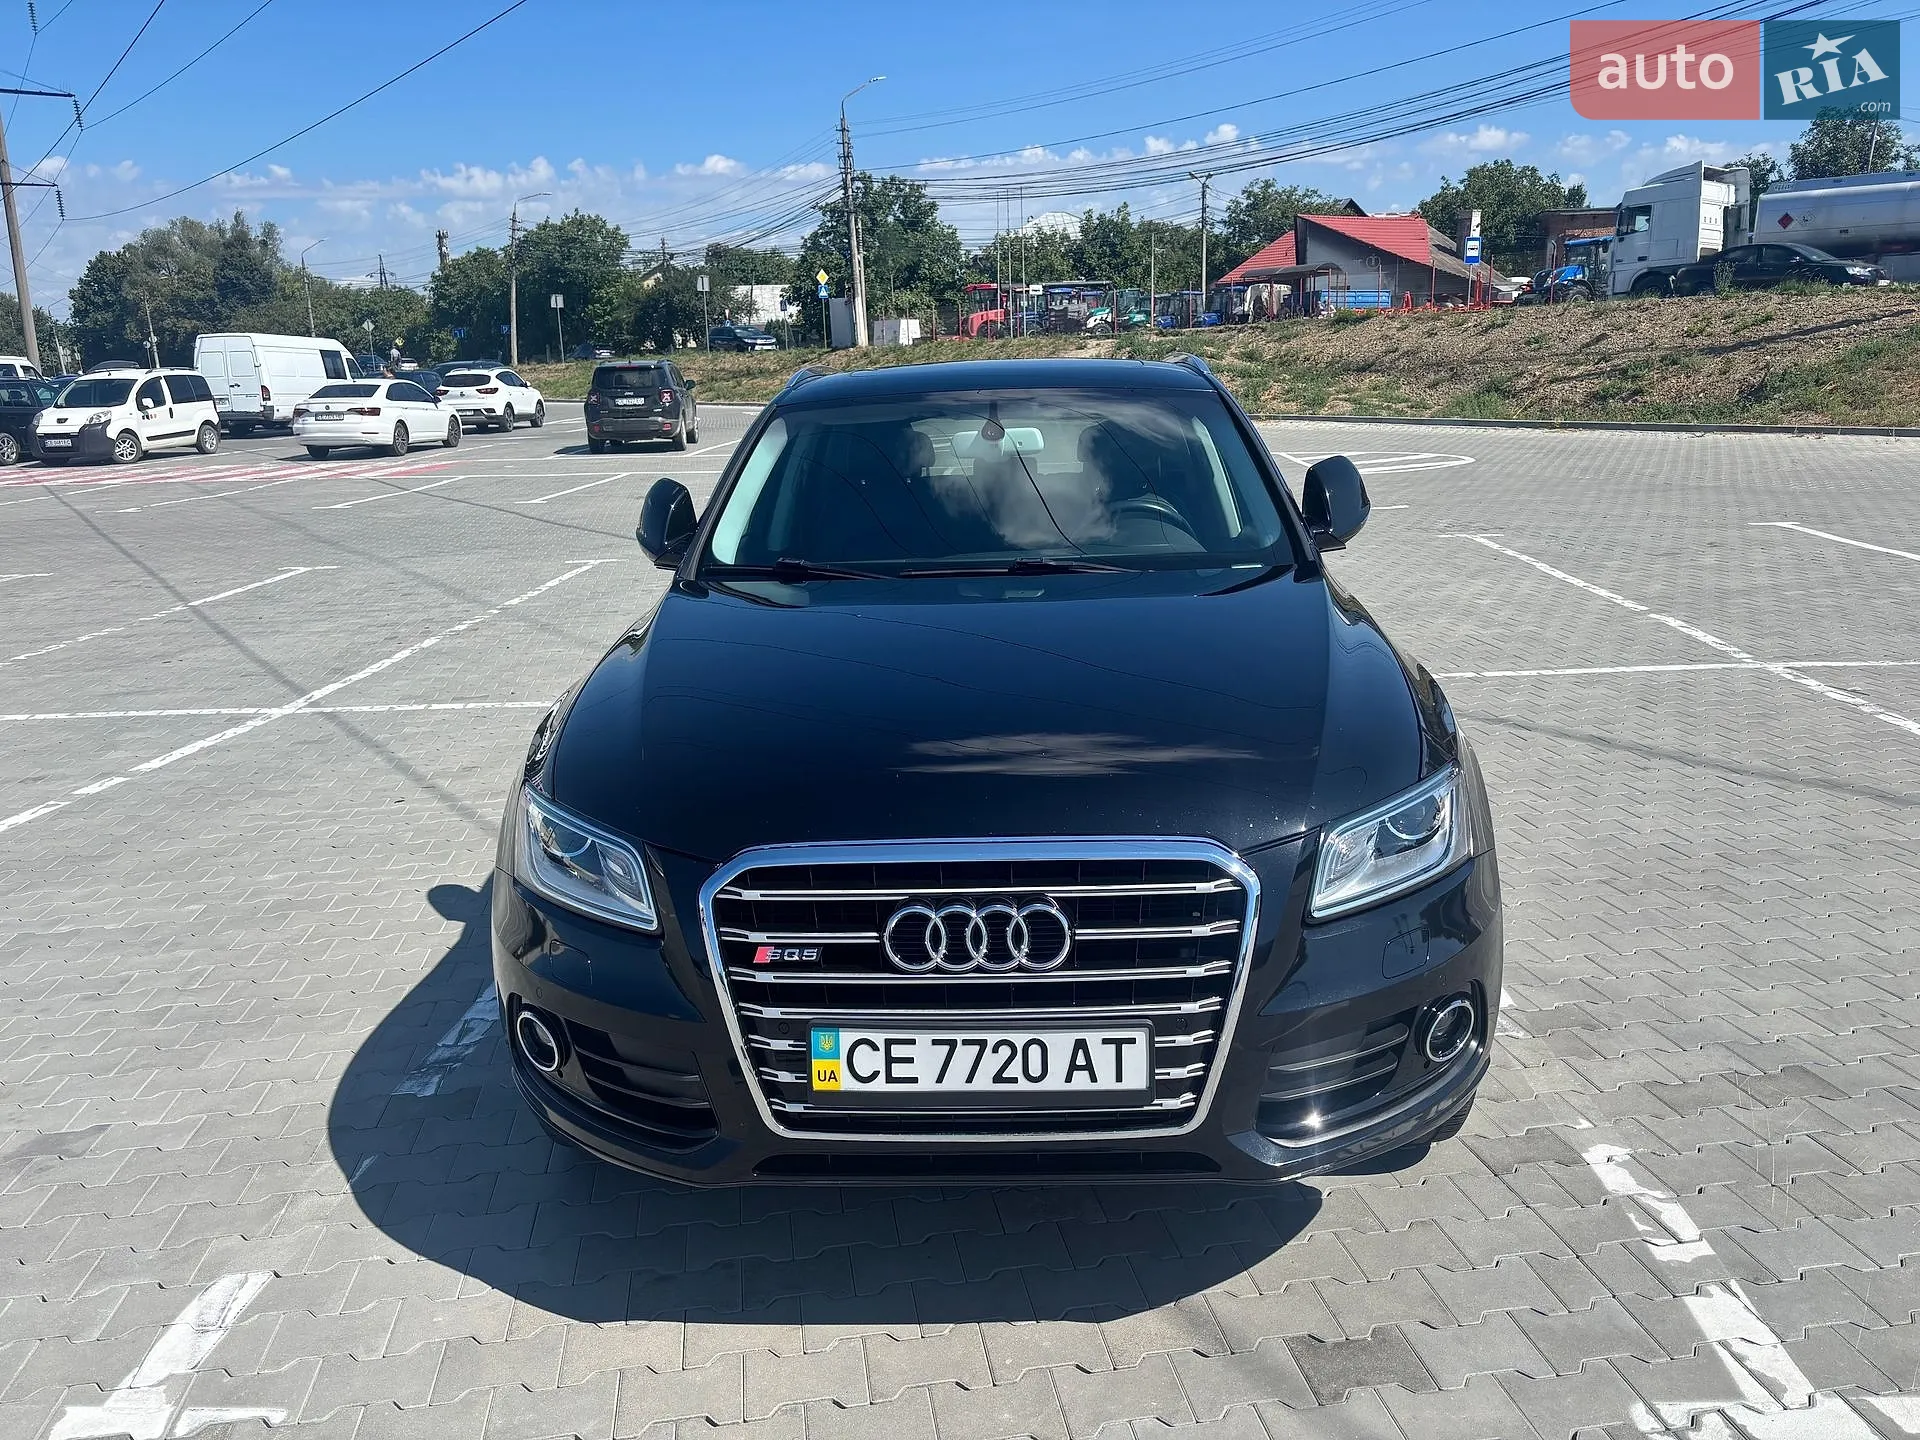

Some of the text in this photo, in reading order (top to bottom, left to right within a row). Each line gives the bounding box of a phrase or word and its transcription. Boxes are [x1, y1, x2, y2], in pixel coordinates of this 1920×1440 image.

[766, 948, 818, 961] SQ5
[846, 1037, 1137, 1084] CE 7720 AT
[817, 1069, 838, 1082] UA
